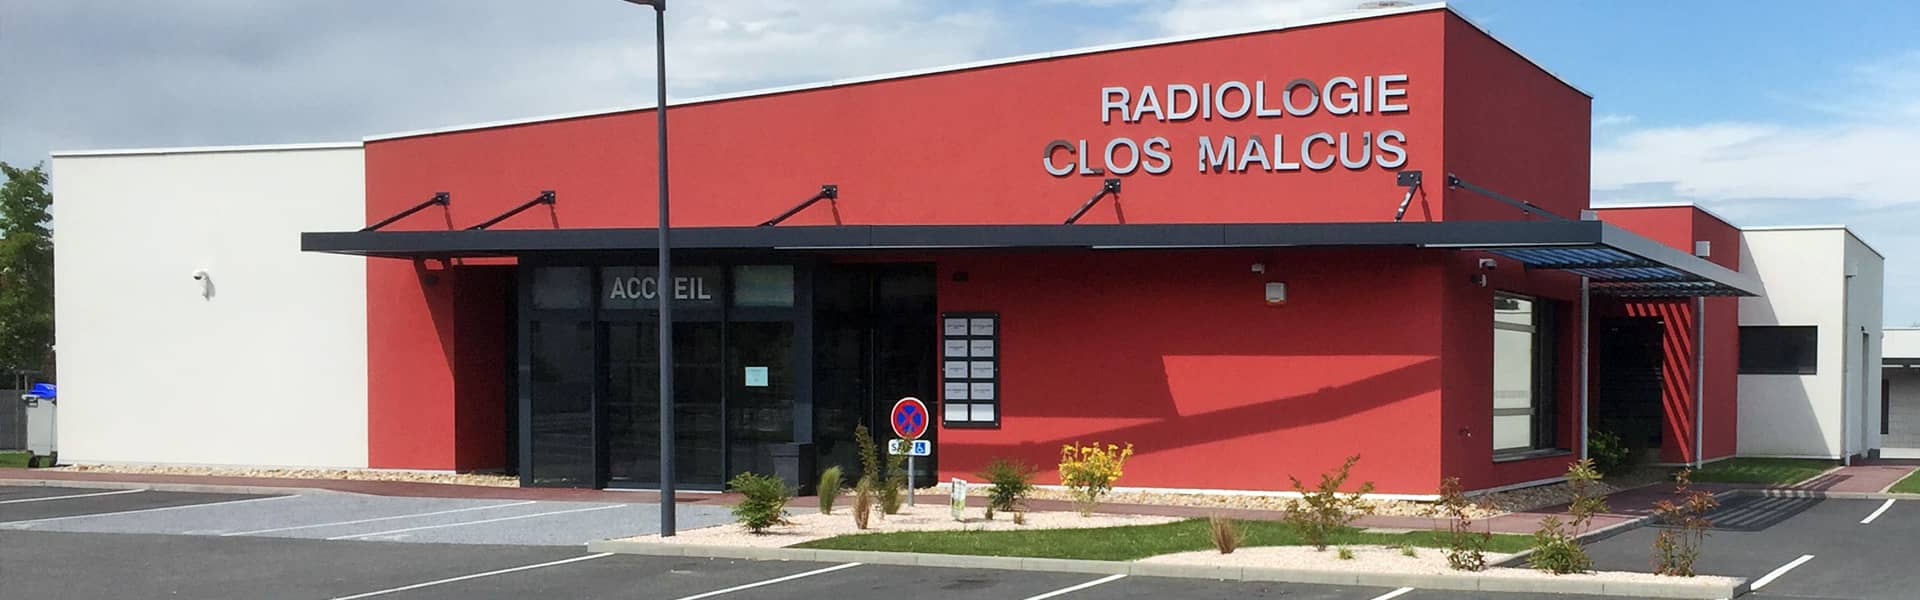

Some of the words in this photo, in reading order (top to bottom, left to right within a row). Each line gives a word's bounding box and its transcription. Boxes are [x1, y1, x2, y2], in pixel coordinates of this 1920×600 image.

[1101, 75, 1409, 123] RADIOLOGIE
[1043, 136, 1172, 177] CLOS
[1199, 130, 1408, 172] MALCUS
[609, 276, 711, 300] ACCEIL
